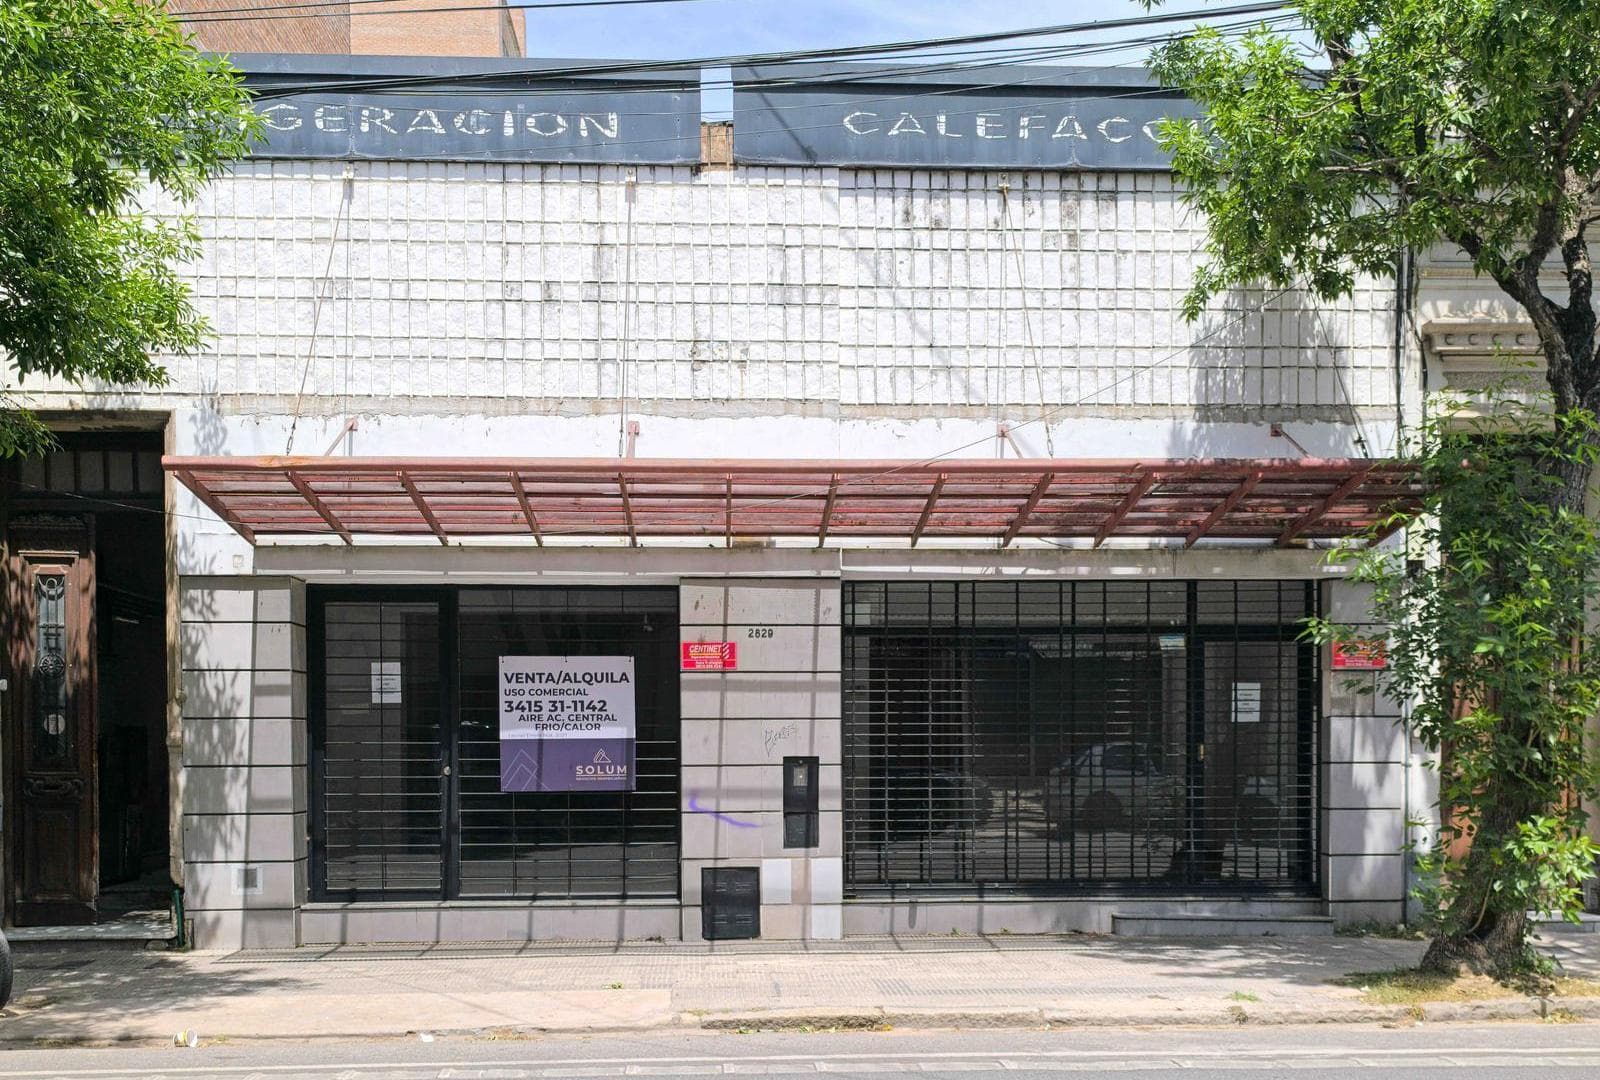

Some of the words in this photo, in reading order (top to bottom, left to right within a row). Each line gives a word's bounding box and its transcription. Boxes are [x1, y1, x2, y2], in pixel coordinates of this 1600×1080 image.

[504, 671, 629, 685] VENTA/ALQUILA
[504, 688, 525, 697] USO
[528, 688, 589, 697] COMERCIAL
[504, 700, 543, 713] 3415
[548, 700, 607, 713] 31-1142
[518, 714, 544, 722] AIRE
[568, 714, 617, 722] CENTRAL
[535, 722, 601, 732] FRIO/CALOR
[576, 765, 627, 774] SOLUM
